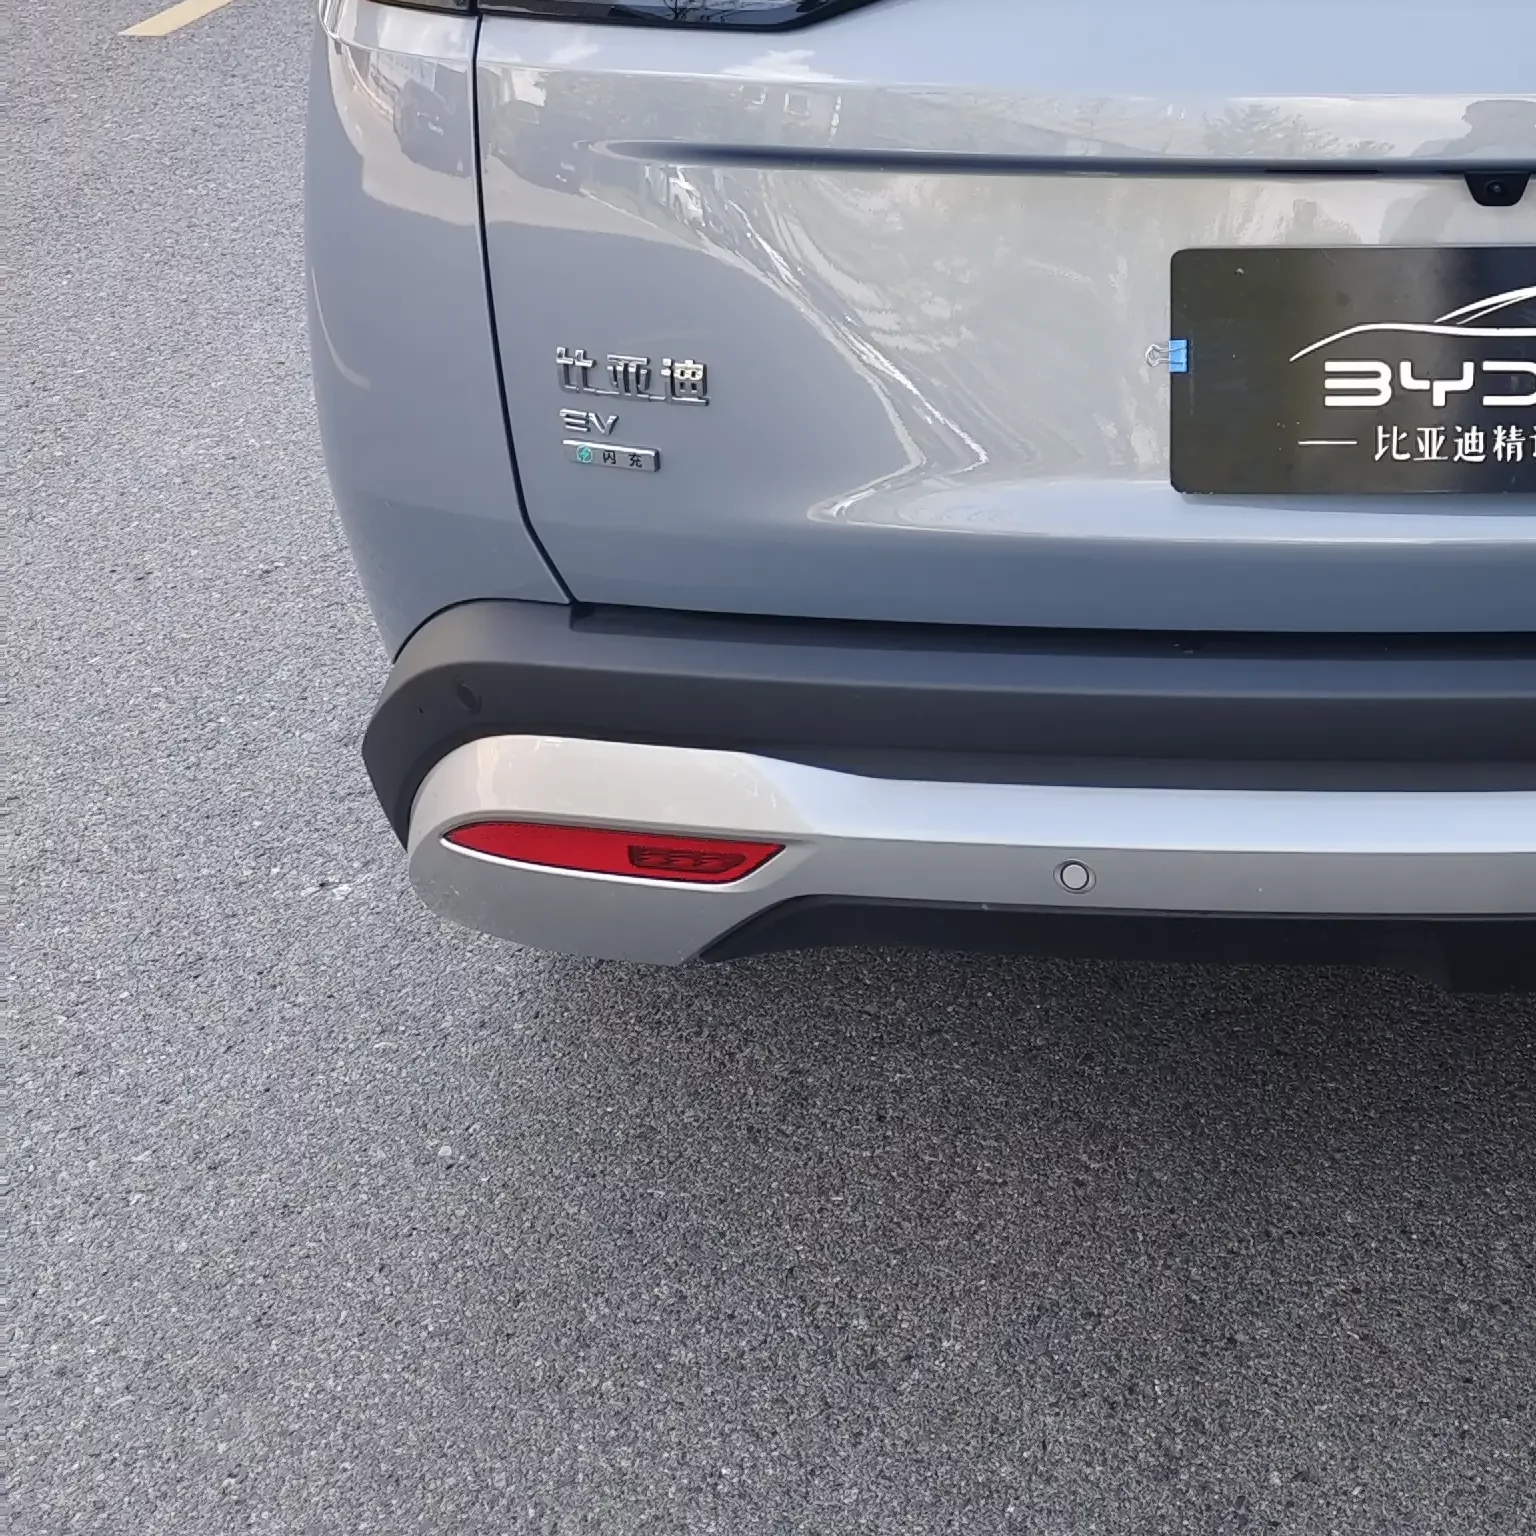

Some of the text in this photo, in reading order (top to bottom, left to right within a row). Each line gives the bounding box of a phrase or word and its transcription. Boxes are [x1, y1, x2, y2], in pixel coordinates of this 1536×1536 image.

[556, 346, 709, 406] 比亚迪
[559, 408, 619, 435] EV
